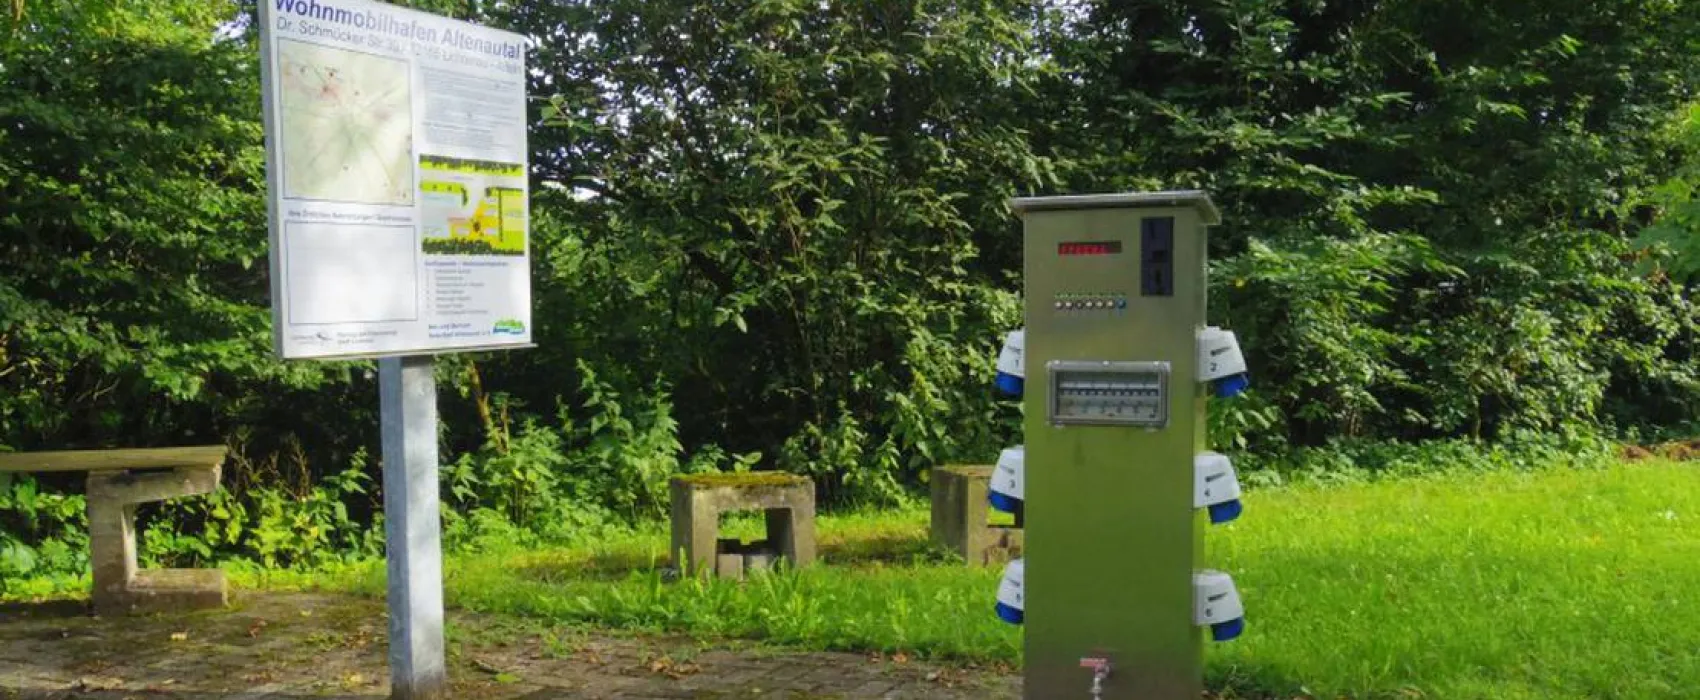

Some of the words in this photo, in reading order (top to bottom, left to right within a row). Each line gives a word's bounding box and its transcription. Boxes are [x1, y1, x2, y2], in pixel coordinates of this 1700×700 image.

[275, 0, 437, 41] Wohnmobilhafen
[441, 28, 520, 60] Altenautal
[276, 16, 295, 32] Dr.
